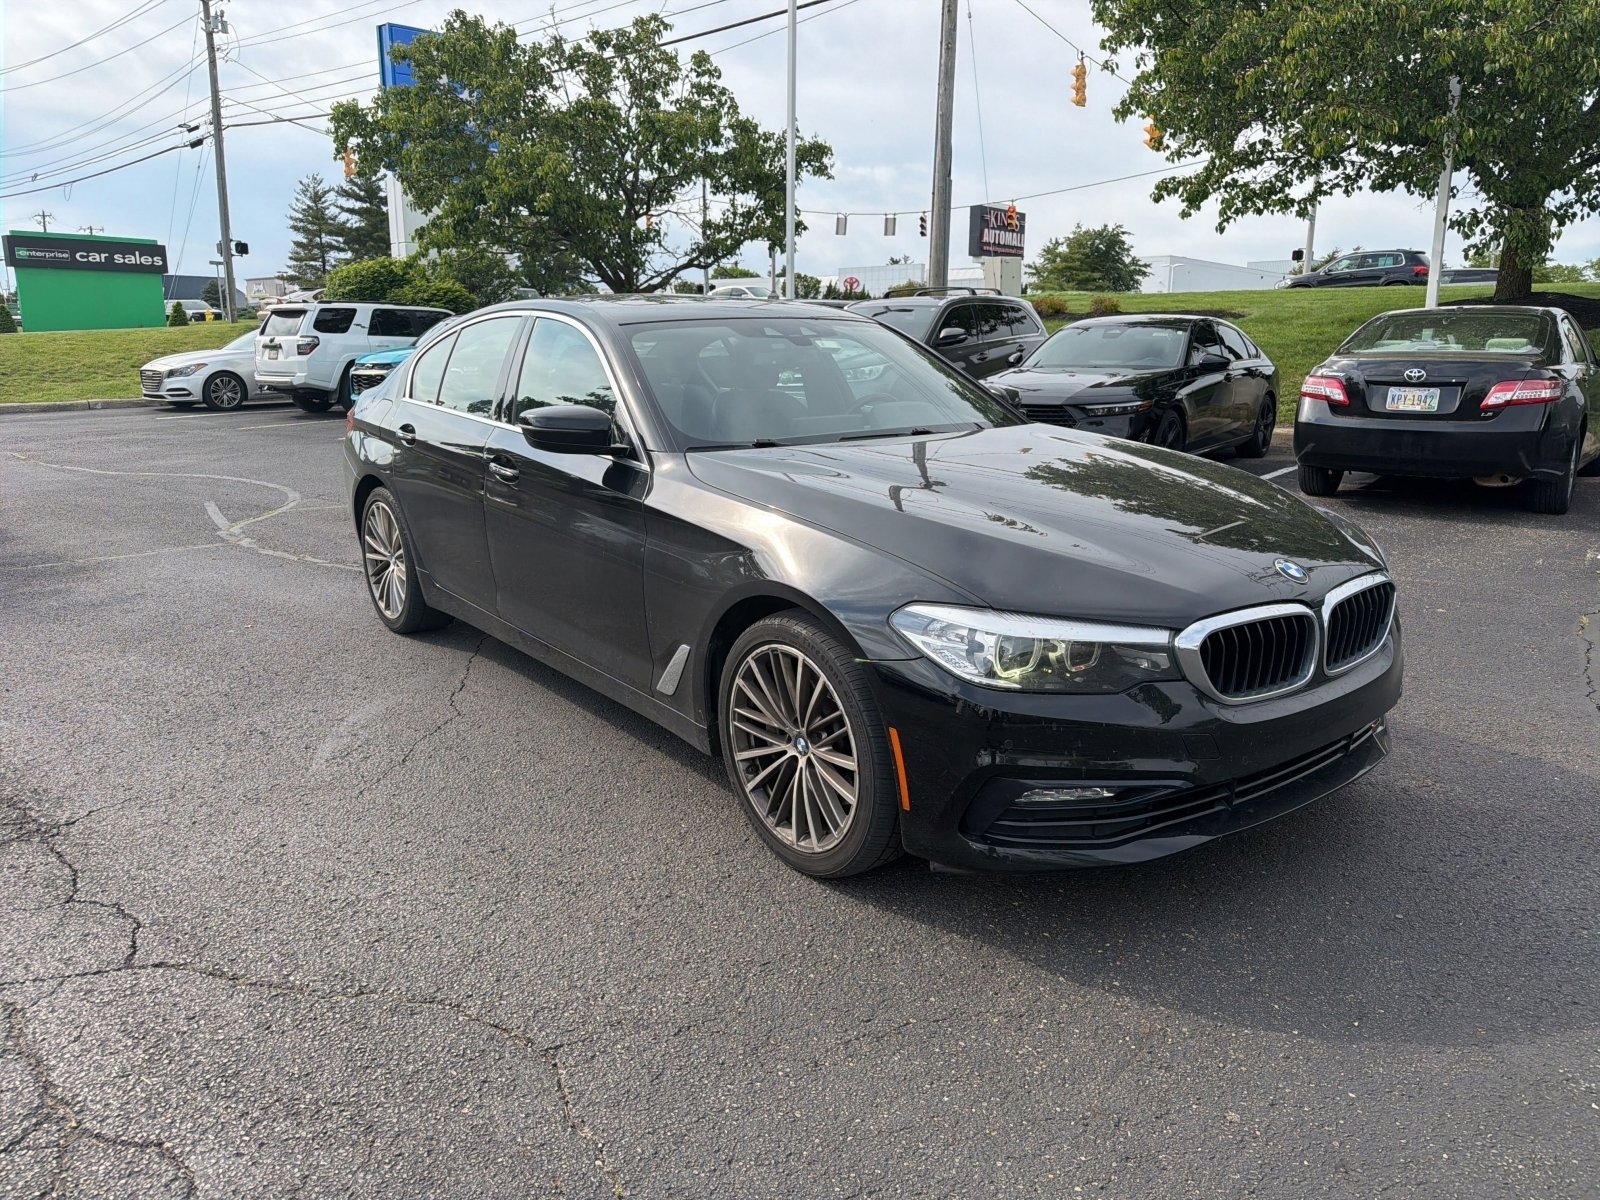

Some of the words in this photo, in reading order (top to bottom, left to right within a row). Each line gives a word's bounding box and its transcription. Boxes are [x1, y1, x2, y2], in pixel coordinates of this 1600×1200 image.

[990, 210, 1020, 232] KINS
[16, 250, 69, 259] enterprise
[75, 251, 109, 263] car
[114, 251, 163, 266] sales
